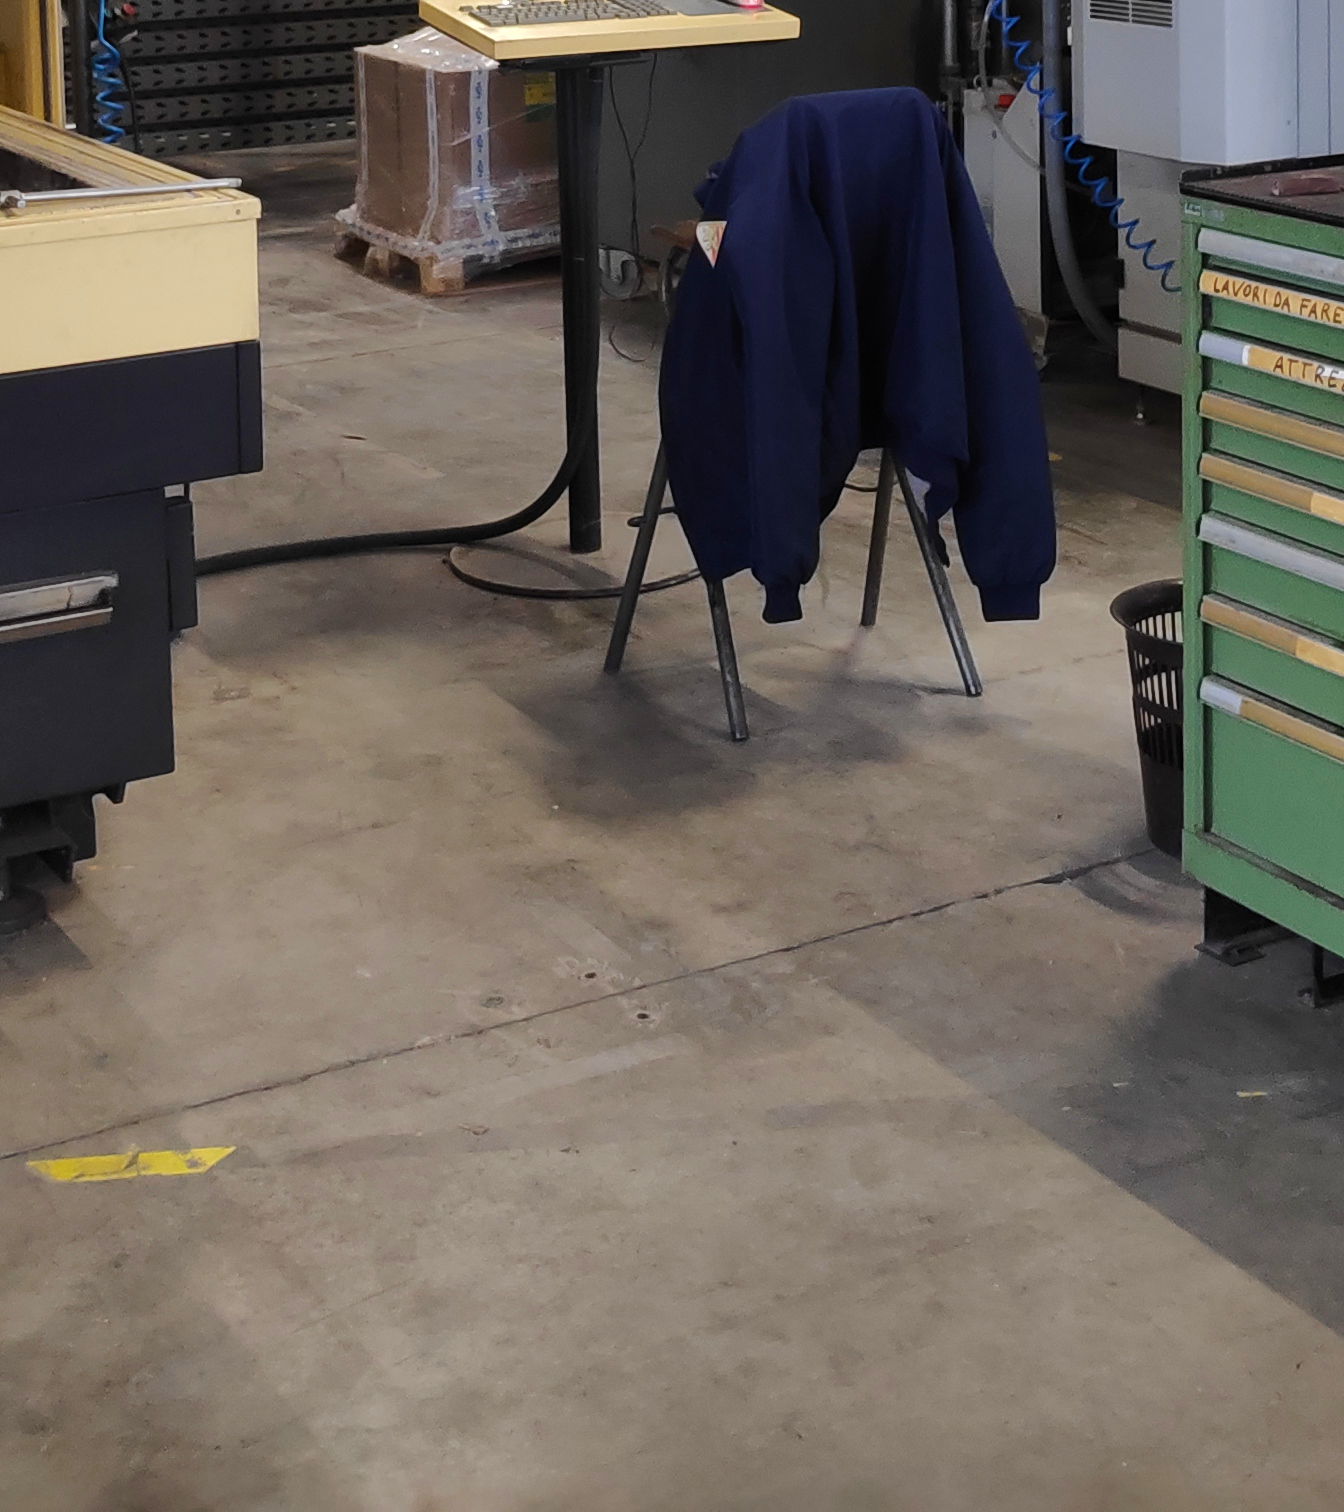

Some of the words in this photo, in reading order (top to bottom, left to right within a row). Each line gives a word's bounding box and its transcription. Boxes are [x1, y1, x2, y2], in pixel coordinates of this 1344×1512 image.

[1213, 277, 1267, 305] LAVORI
[1273, 291, 1291, 313] DA
[1299, 298, 1344, 325] FARE
